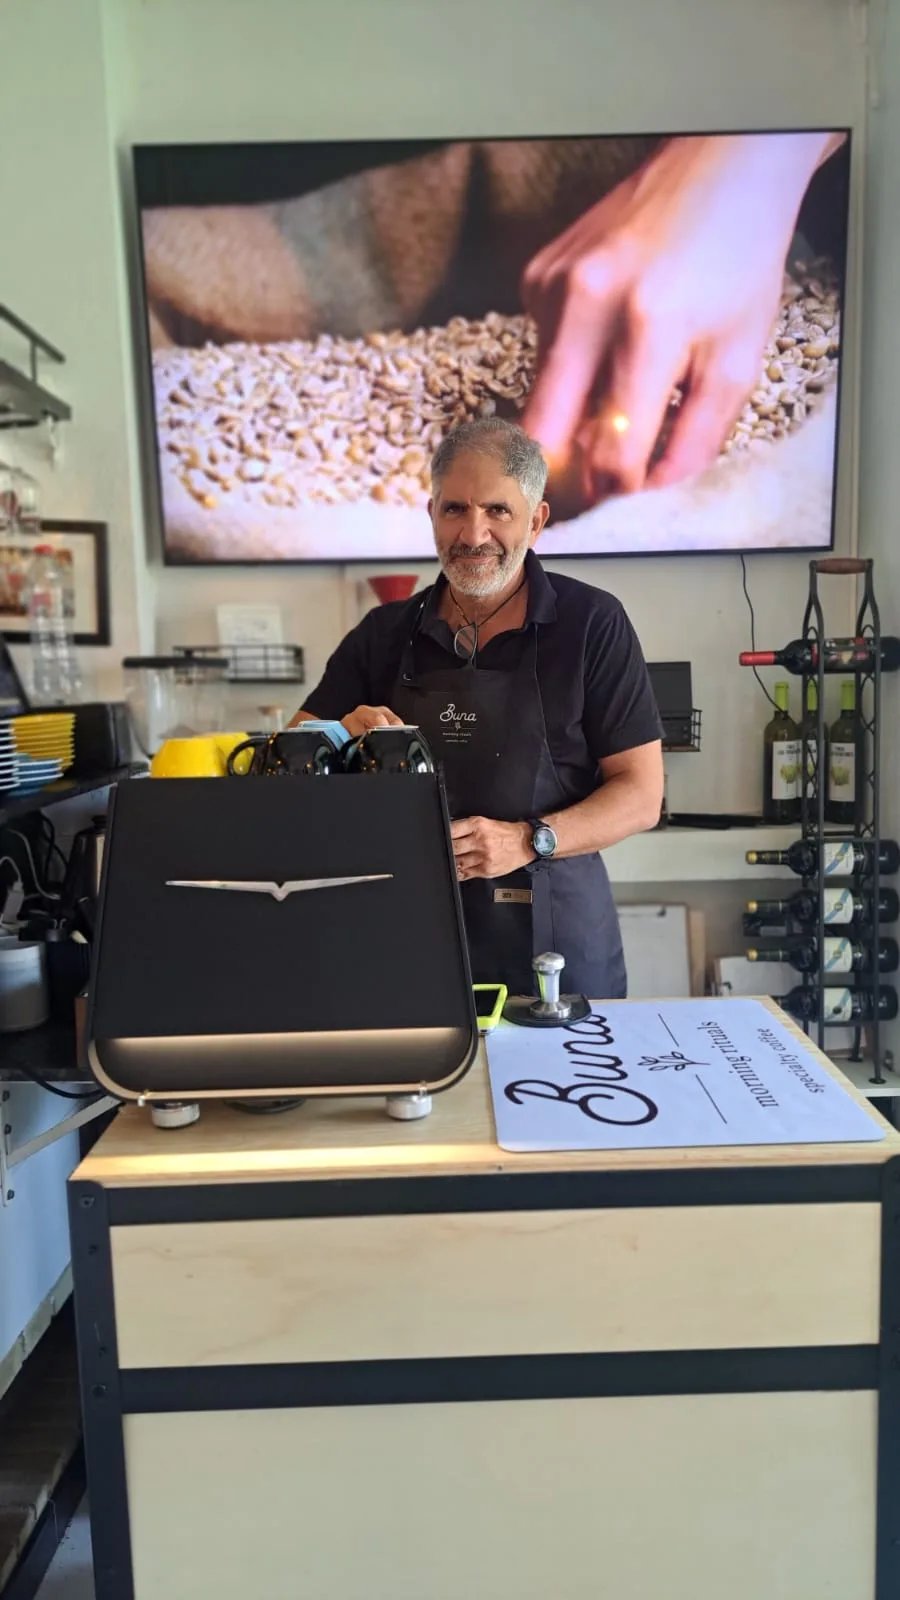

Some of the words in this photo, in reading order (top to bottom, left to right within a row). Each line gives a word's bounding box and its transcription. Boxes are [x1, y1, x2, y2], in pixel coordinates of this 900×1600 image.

[440, 703, 477, 722] Buna
[697, 1021, 738, 1053] rituals
[757, 1028, 787, 1052] coffee
[726, 1055, 780, 1107] morning
[778, 1053, 826, 1094] specialty
